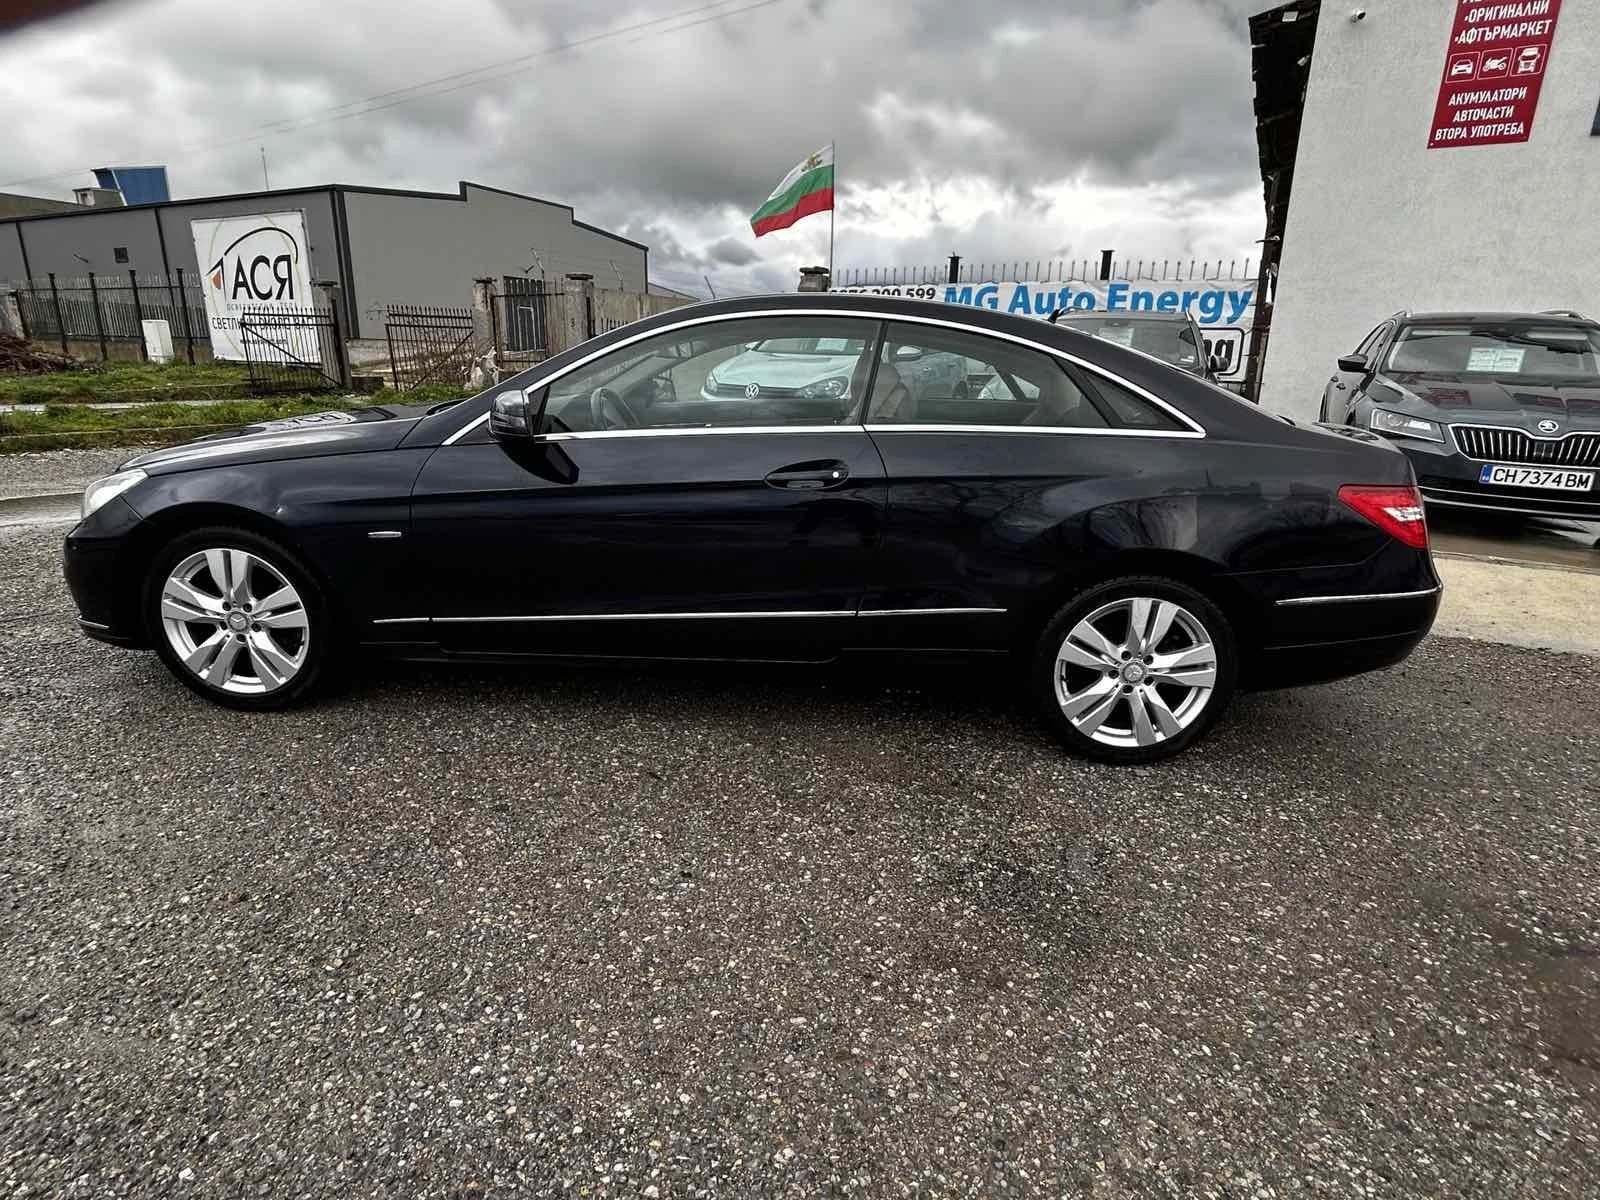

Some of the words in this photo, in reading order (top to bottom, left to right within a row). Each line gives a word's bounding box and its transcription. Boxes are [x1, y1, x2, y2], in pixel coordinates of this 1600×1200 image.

[1468, 0, 1550, 23] ОРИГИНАЛНИ
[1457, 20, 1552, 44] АФТЪРМАРКЕТ
[1448, 87, 1527, 106] АКУМУЛАТОРИ
[1453, 105, 1514, 122] АВТОЧАСТИ
[1434, 126, 1467, 141] ВТОРА
[1470, 122, 1524, 138] УПОТРЕБА
[232, 255, 294, 300] АСЯ
[906, 287, 936, 300] 599
[943, 285, 999, 308] MG
[1007, 285, 1096, 315] Auto
[1107, 283, 1253, 324] Energy
